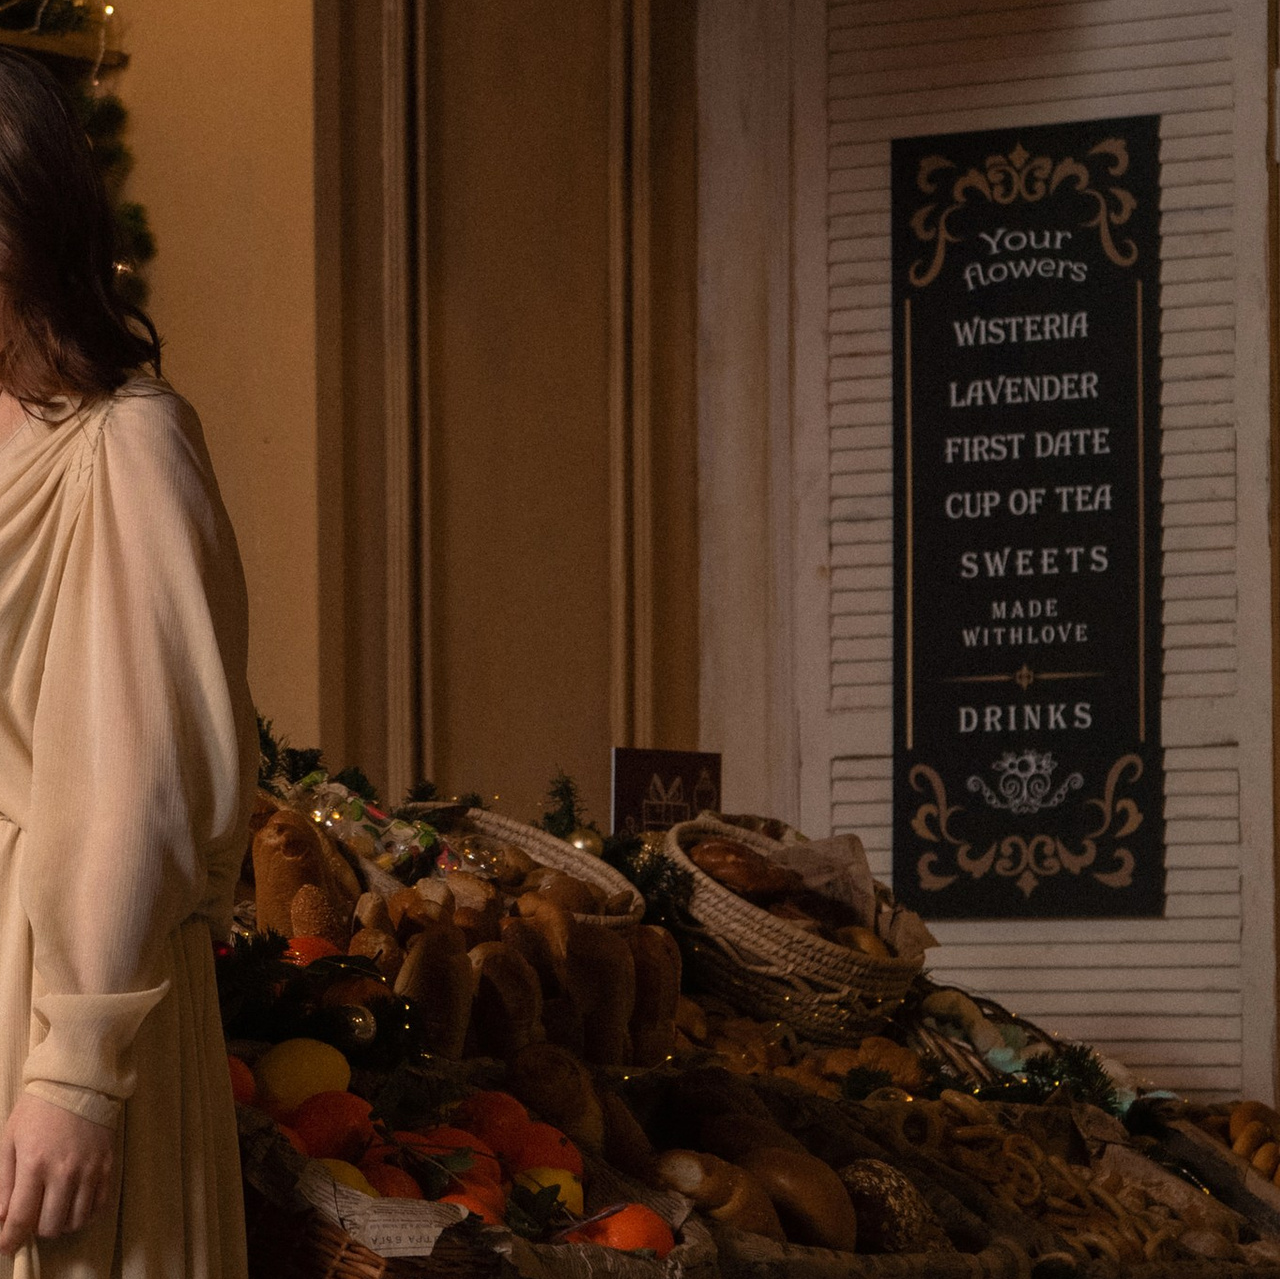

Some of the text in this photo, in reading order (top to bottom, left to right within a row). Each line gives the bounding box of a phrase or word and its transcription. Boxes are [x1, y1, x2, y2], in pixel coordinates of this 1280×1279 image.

[977, 226, 1073, 256] Your
[963, 256, 1089, 292] flowers
[952, 309, 1090, 348] WISTERIA
[948, 370, 1100, 409] LAVENDER
[944, 426, 1112, 464] FIRST DATE
[944, 483, 1113, 520] CUP OF TEA
[960, 544, 1110, 580] SWEETS
[990, 597, 1059, 621] MADE
[957, 700, 1094, 734] DRINKS
